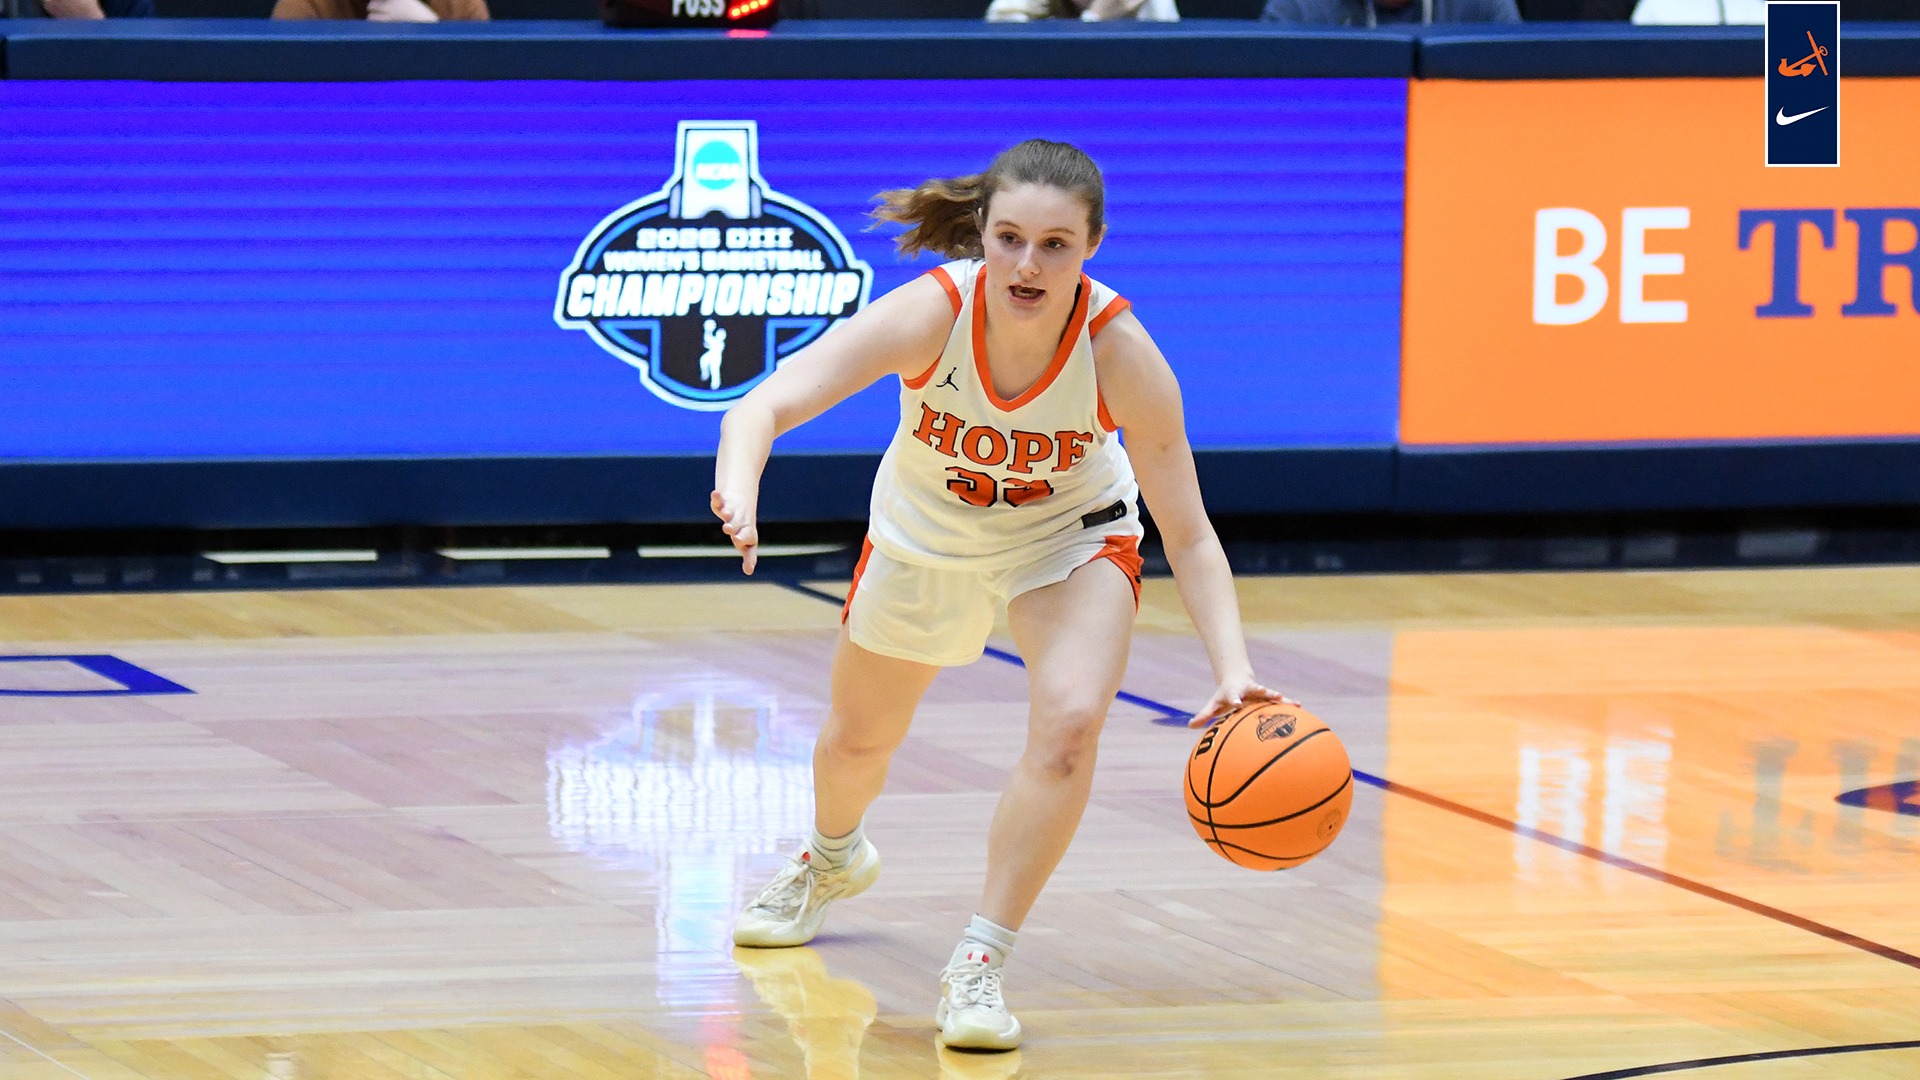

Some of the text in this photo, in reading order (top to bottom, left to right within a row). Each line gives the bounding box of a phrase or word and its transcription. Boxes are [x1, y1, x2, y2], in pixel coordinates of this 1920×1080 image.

[603, 250, 826, 271] WOMEN'S BASKETBALL
[725, 227, 795, 249] DIII
[1532, 206, 1691, 325] BE
[566, 272, 861, 317] CHAMPIONSHIP
[912, 401, 1093, 474] HOPE
